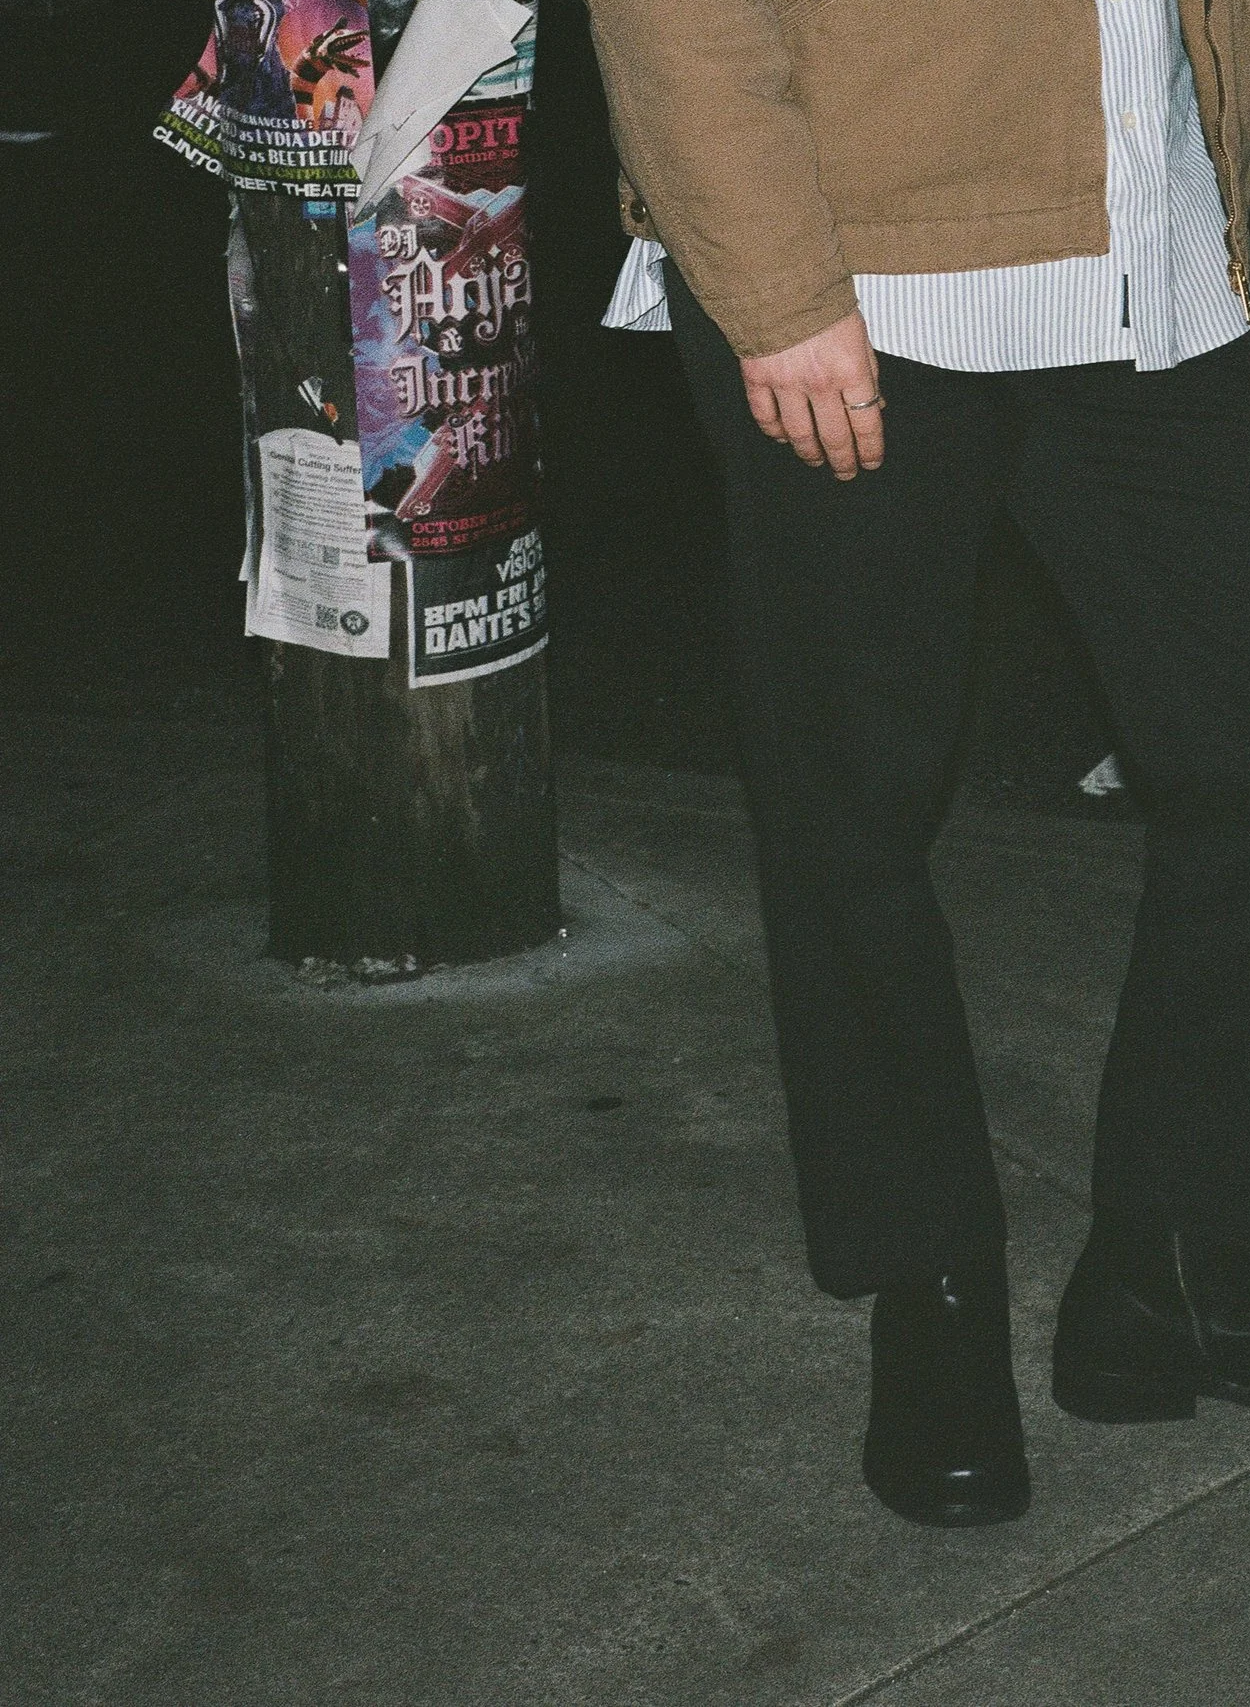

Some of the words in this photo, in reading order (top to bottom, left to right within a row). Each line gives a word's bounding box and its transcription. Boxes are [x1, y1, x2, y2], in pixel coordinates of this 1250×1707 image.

[291, 119, 314, 130] BY:
[239, 130, 254, 143] as
[256, 129, 305, 147] LYDIA
[428, 115, 524, 154] OPIT
[249, 149, 266, 163] as
[298, 458, 332, 473] Cutting
[496, 581, 529, 611] FRI
